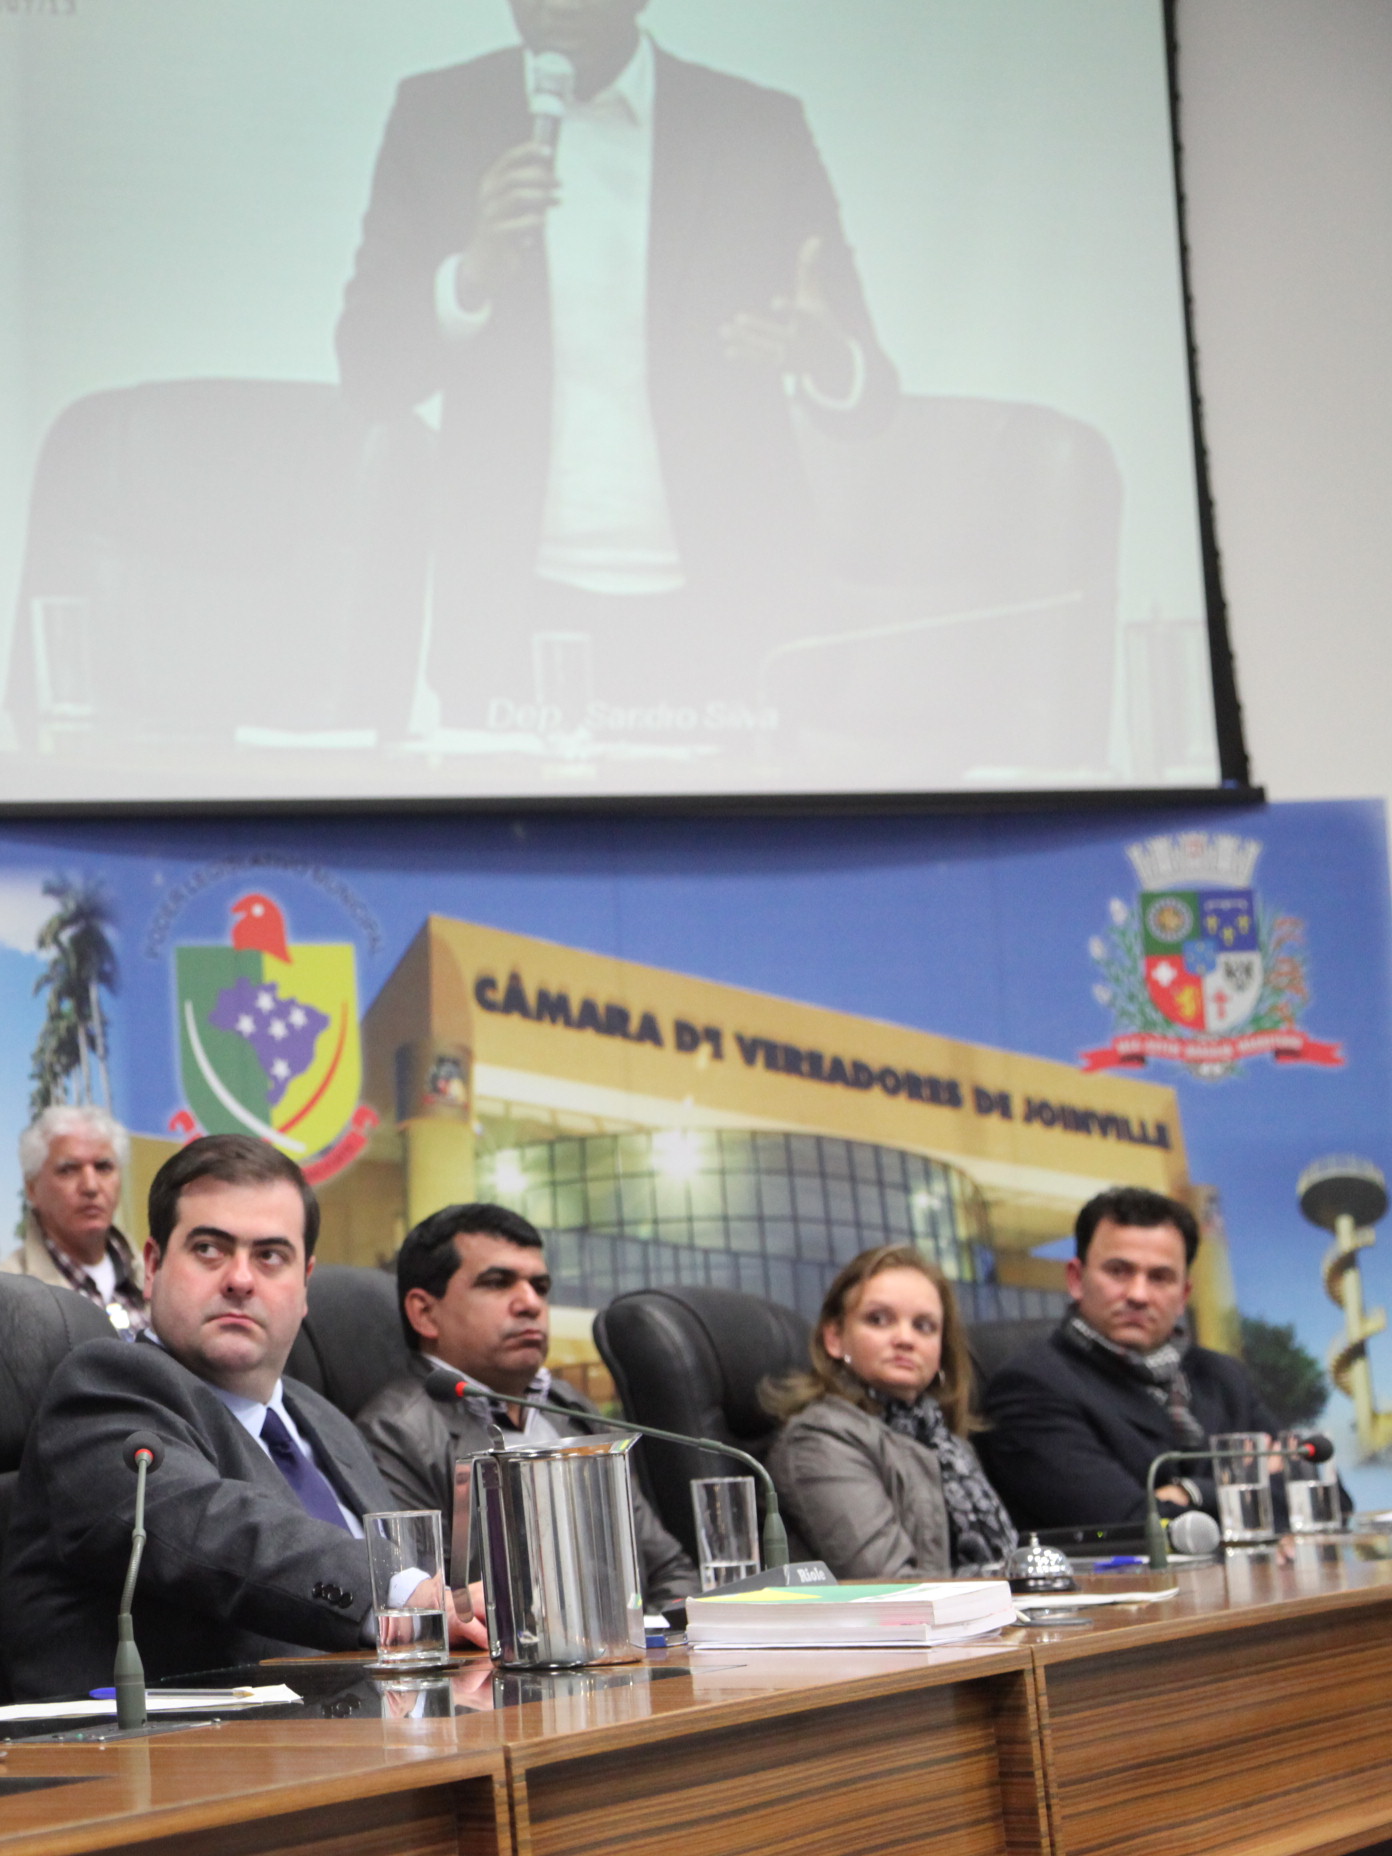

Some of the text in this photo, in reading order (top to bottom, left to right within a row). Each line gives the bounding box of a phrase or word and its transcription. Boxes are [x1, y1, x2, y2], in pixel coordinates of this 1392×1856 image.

[473, 971, 664, 1049] CÂMARA
[732, 1030, 963, 1109] VEREADORES
[971, 1085, 1014, 1121] DE
[1021, 1096, 1173, 1150] JOINVILLE
[796, 1566, 827, 1583] Riole
